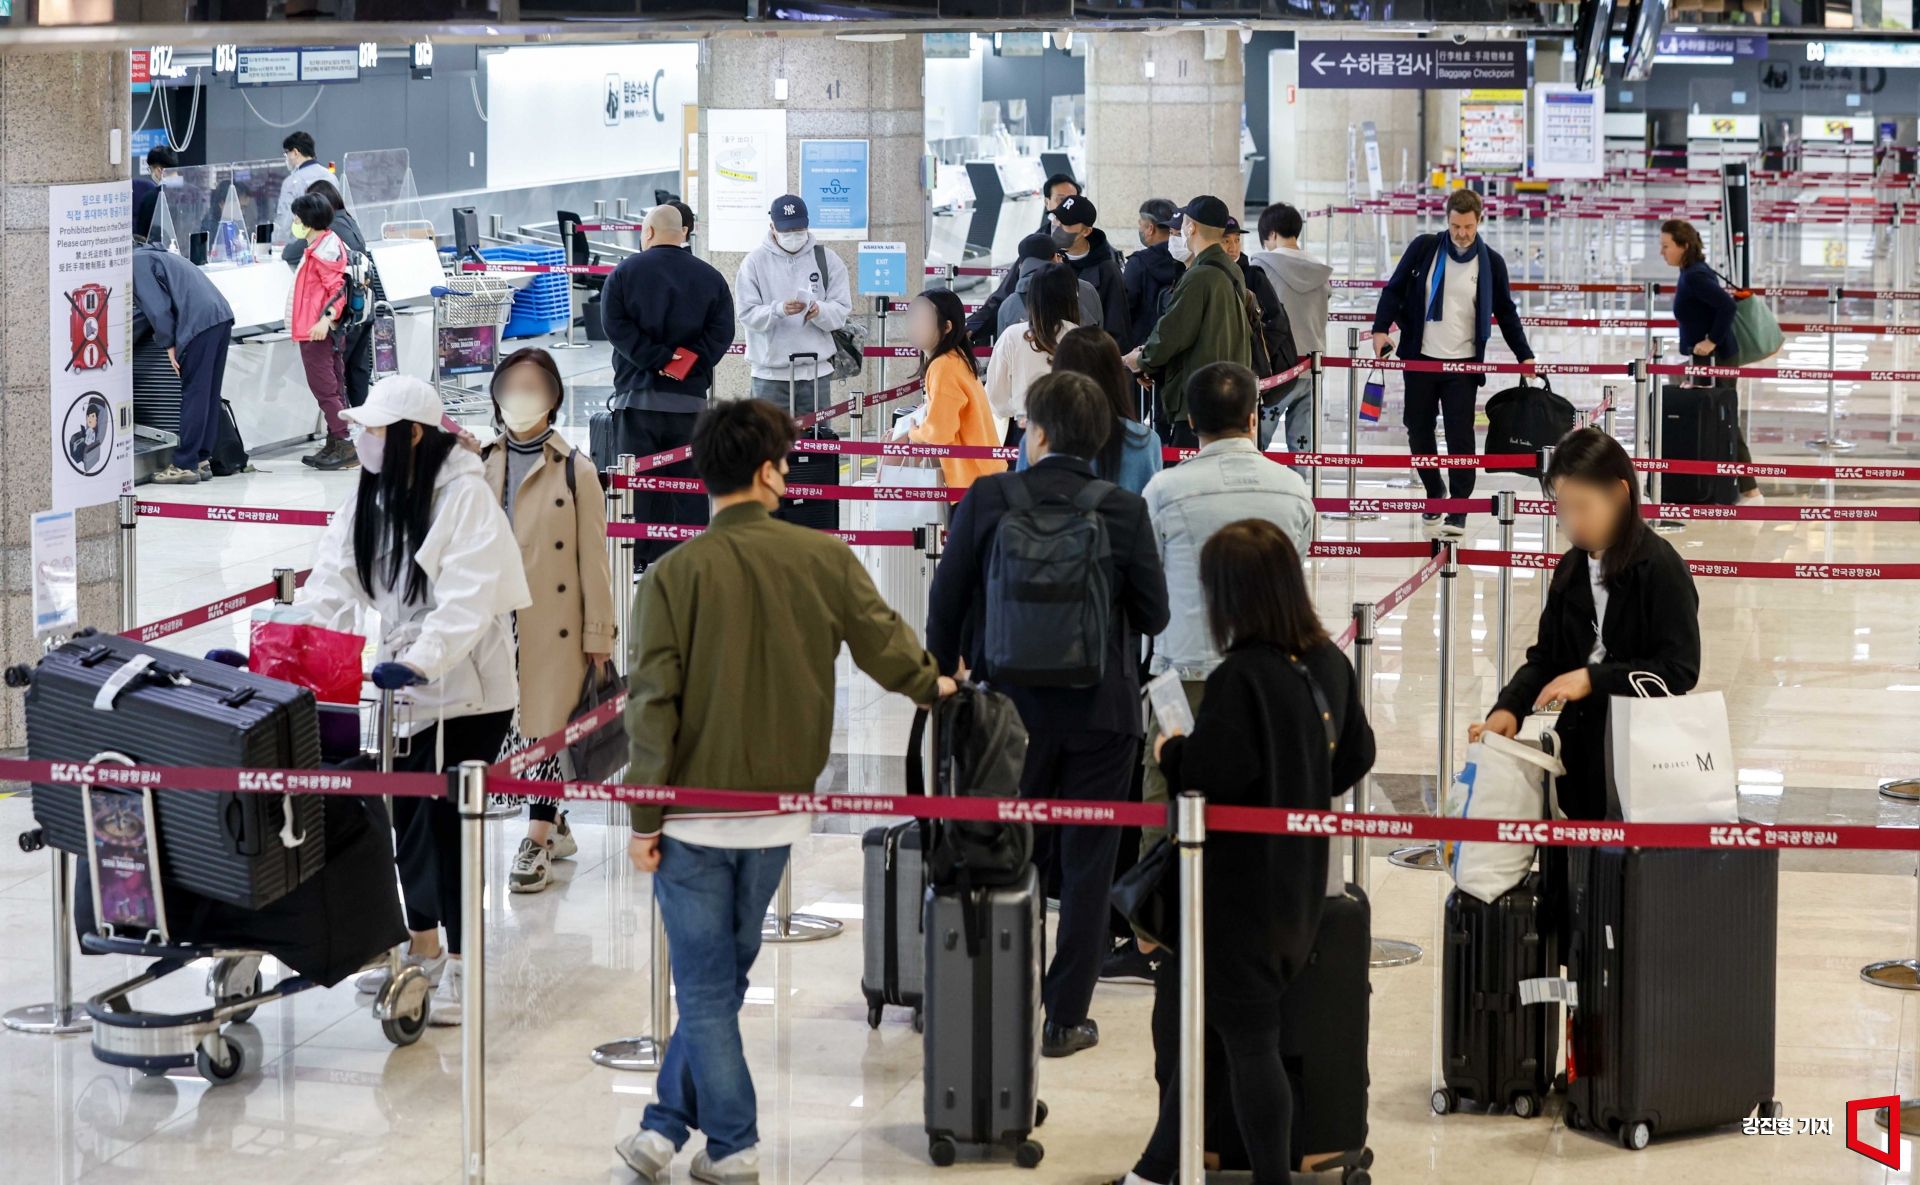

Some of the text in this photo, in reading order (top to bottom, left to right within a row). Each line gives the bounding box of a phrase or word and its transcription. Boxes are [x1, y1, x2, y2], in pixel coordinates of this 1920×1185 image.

[1339, 53, 1432, 76] 수하물검사
[1439, 68, 1515, 79] Baggage Checkpoint
[624, 81, 649, 103] 탑승수속
[653, 69, 664, 122] C
[82, 195, 102, 206] 짐으로
[1063, 199, 1075, 211] R
[66, 210, 81, 221] 직접
[84, 208, 109, 220] 휴대하여
[60, 224, 92, 235] Prohibited
[93, 224, 107, 232] Items
[80, 239, 94, 247] carry
[895, 303, 909, 311] KA
[1520, 318, 1540, 326] KAC
[1600, 319, 1619, 327] KAC
[1804, 324, 1824, 332] KAC
[895, 348, 916, 357] KAC
[1352, 359, 1406, 369] KAC 한국공항공사
[1443, 362, 1497, 372] KAC 한국공항공사
[1534, 365, 1557, 373] KAC
[1684, 366, 1740, 376] KAC 한국공항공사
[1777, 370, 1800, 378] KAC
[1871, 372, 1893, 380] KAC
[804, 442, 841, 451] 한국공항공사
[883, 444, 950, 456] KAC 한국공항공사
[1294, 454, 1363, 466] KAC 한국공항공사
[1411, 456, 1480, 467] KAC 한국공항공사
[1717, 463, 1787, 475] KAC 한국공항공사
[1835, 467, 1905, 478] KAC 한국공항공사
[627, 477, 699, 491] KAC 한국공항공사
[874, 488, 947, 499] KAC 한국공항공사
[1349, 500, 1426, 511] KAC 한국공항공사
[1518, 502, 1550, 513] KAC
[207, 508, 279, 521] KAC 한국공항공사
[1659, 506, 1737, 518] KAC 한국공항공사
[1800, 508, 1878, 519] KAC 한국공항공사
[646, 526, 678, 538] KAC
[1314, 545, 1361, 555] 한국공항공사
[1510, 554, 1545, 567] KAC
[1689, 564, 1738, 575] 한국공항공사
[1795, 565, 1881, 578] KAC 한국공항공사
[208, 602, 224, 620] KAC
[142, 623, 159, 642] KAC
[1652, 761, 1689, 770] PROJECT
[51, 763, 161, 784] KAC 한국공항공사
[239, 771, 352, 790] KAC 한국공항공사
[563, 785, 676, 800] KAC 한국공항공사
[778, 794, 894, 812] KAC 한국공항공사
[997, 801, 1114, 822] KAC 한국공항공사
[1287, 813, 1414, 835] KAC 한국공항공사
[1498, 822, 1625, 842] KAC 한국공항공사
[1709, 826, 1838, 845] KAC 한국공항공사
